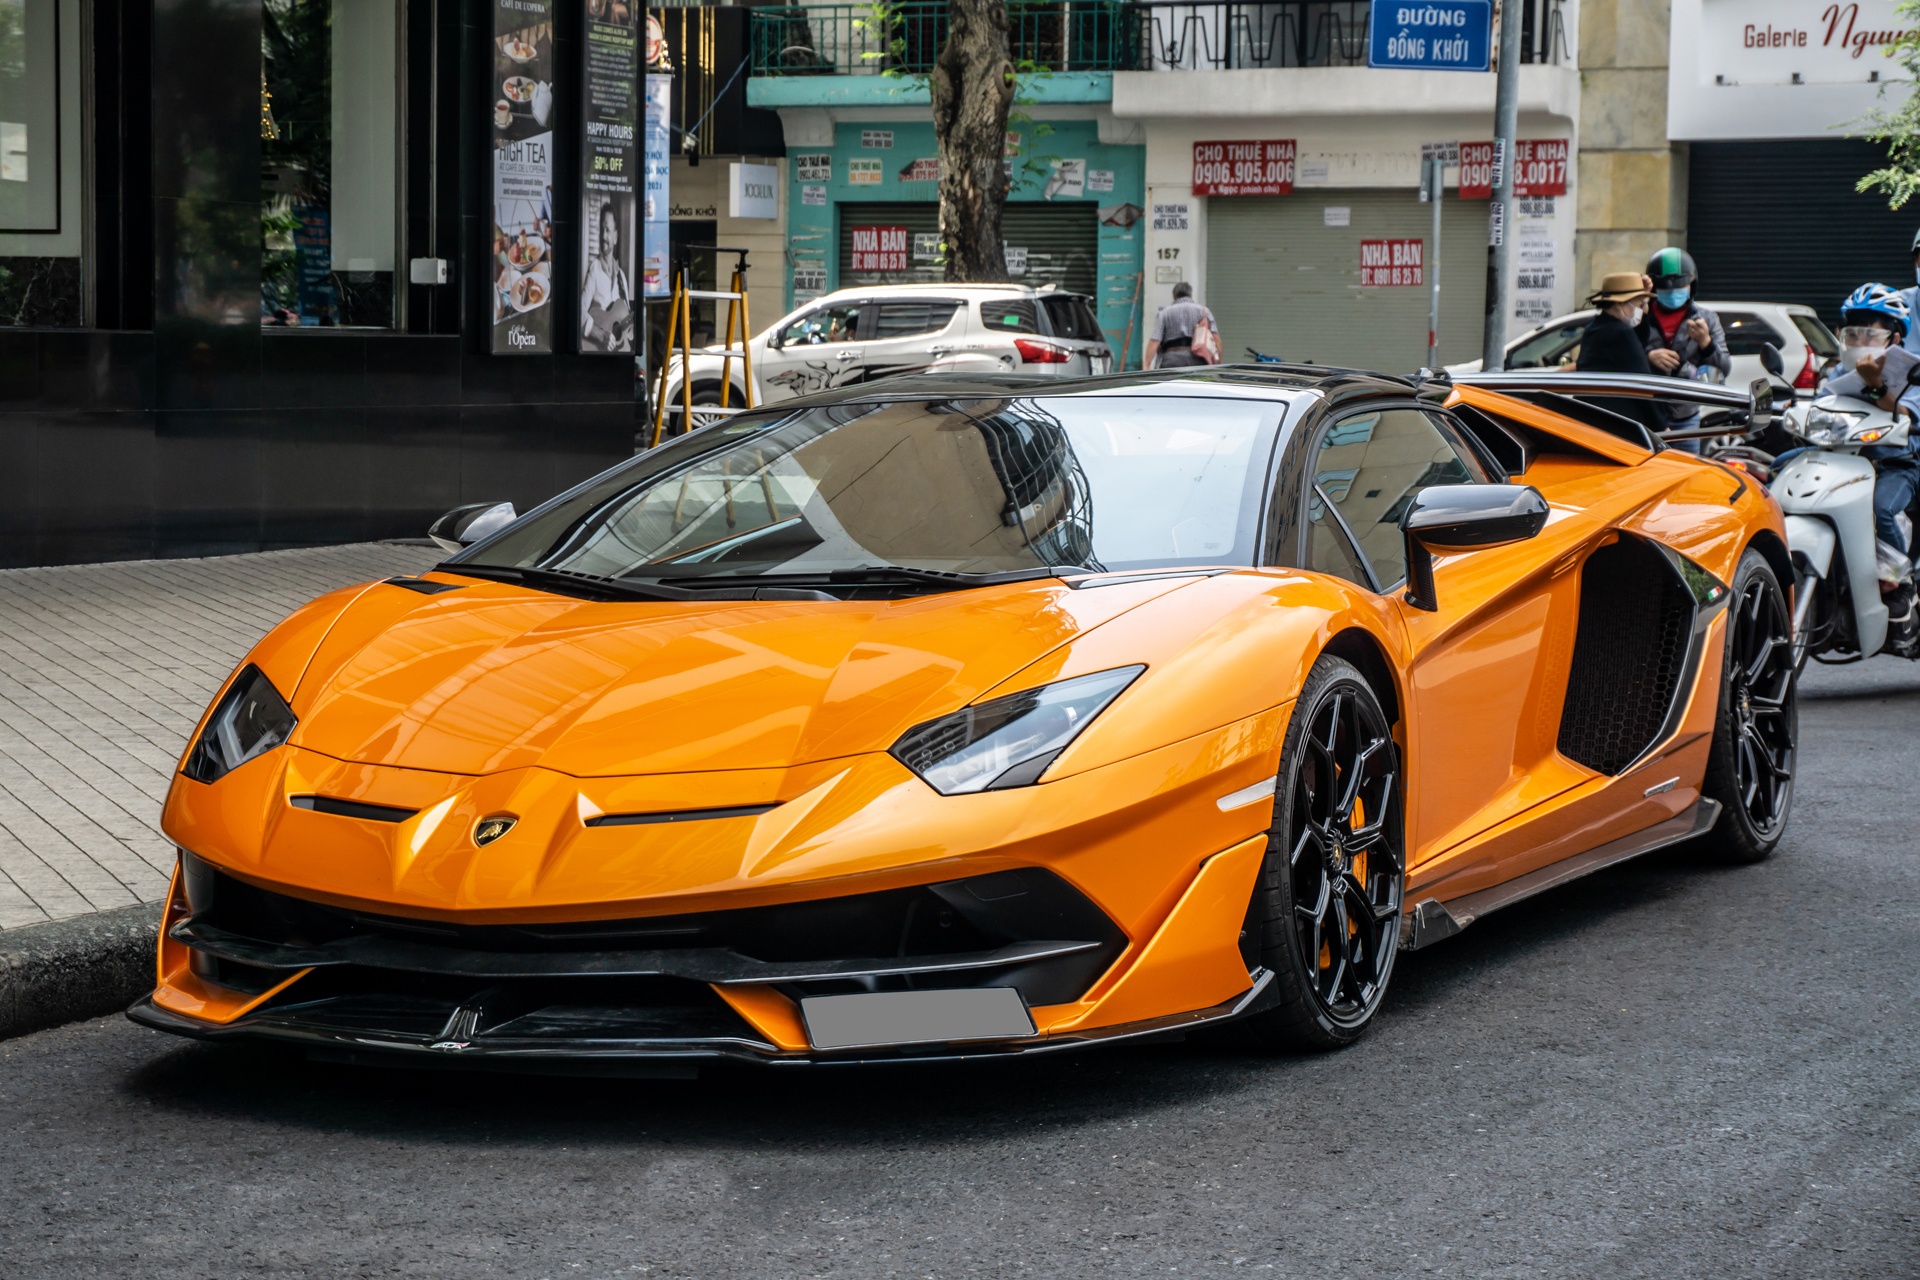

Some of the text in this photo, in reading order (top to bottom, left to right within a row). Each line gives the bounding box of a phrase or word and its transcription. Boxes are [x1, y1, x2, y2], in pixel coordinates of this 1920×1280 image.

[1397, 5, 1466, 26] ĐƯỜNG
[1388, 29, 1468, 62] ĐỒNG KHỞI
[1745, 24, 1807, 48] Galerie
[587, 121, 608, 136] HAPPY
[609, 124, 633, 139] HOURS
[500, 140, 546, 164] HIGH TEA
[1195, 140, 1294, 162] CHO THUÊ NHÀ
[1462, 140, 1566, 162] CHO UÊ NHÀ
[594, 156, 623, 171] 50% OFF
[1195, 161, 1294, 185] 0906.905.006
[696, 205, 717, 216] KHỞI
[854, 227, 878, 251] NHÀ
[881, 227, 906, 251] BÁN
[863, 253, 878, 269] 0901
[889, 253, 897, 269] 25
[1158, 249, 1180, 259] 157
[1362, 240, 1421, 266] NHÀ BÁN
[1374, 268, 1390, 284] 0901
[1403, 268, 1412, 284] 25
[508, 331, 536, 349] l'Opéra
